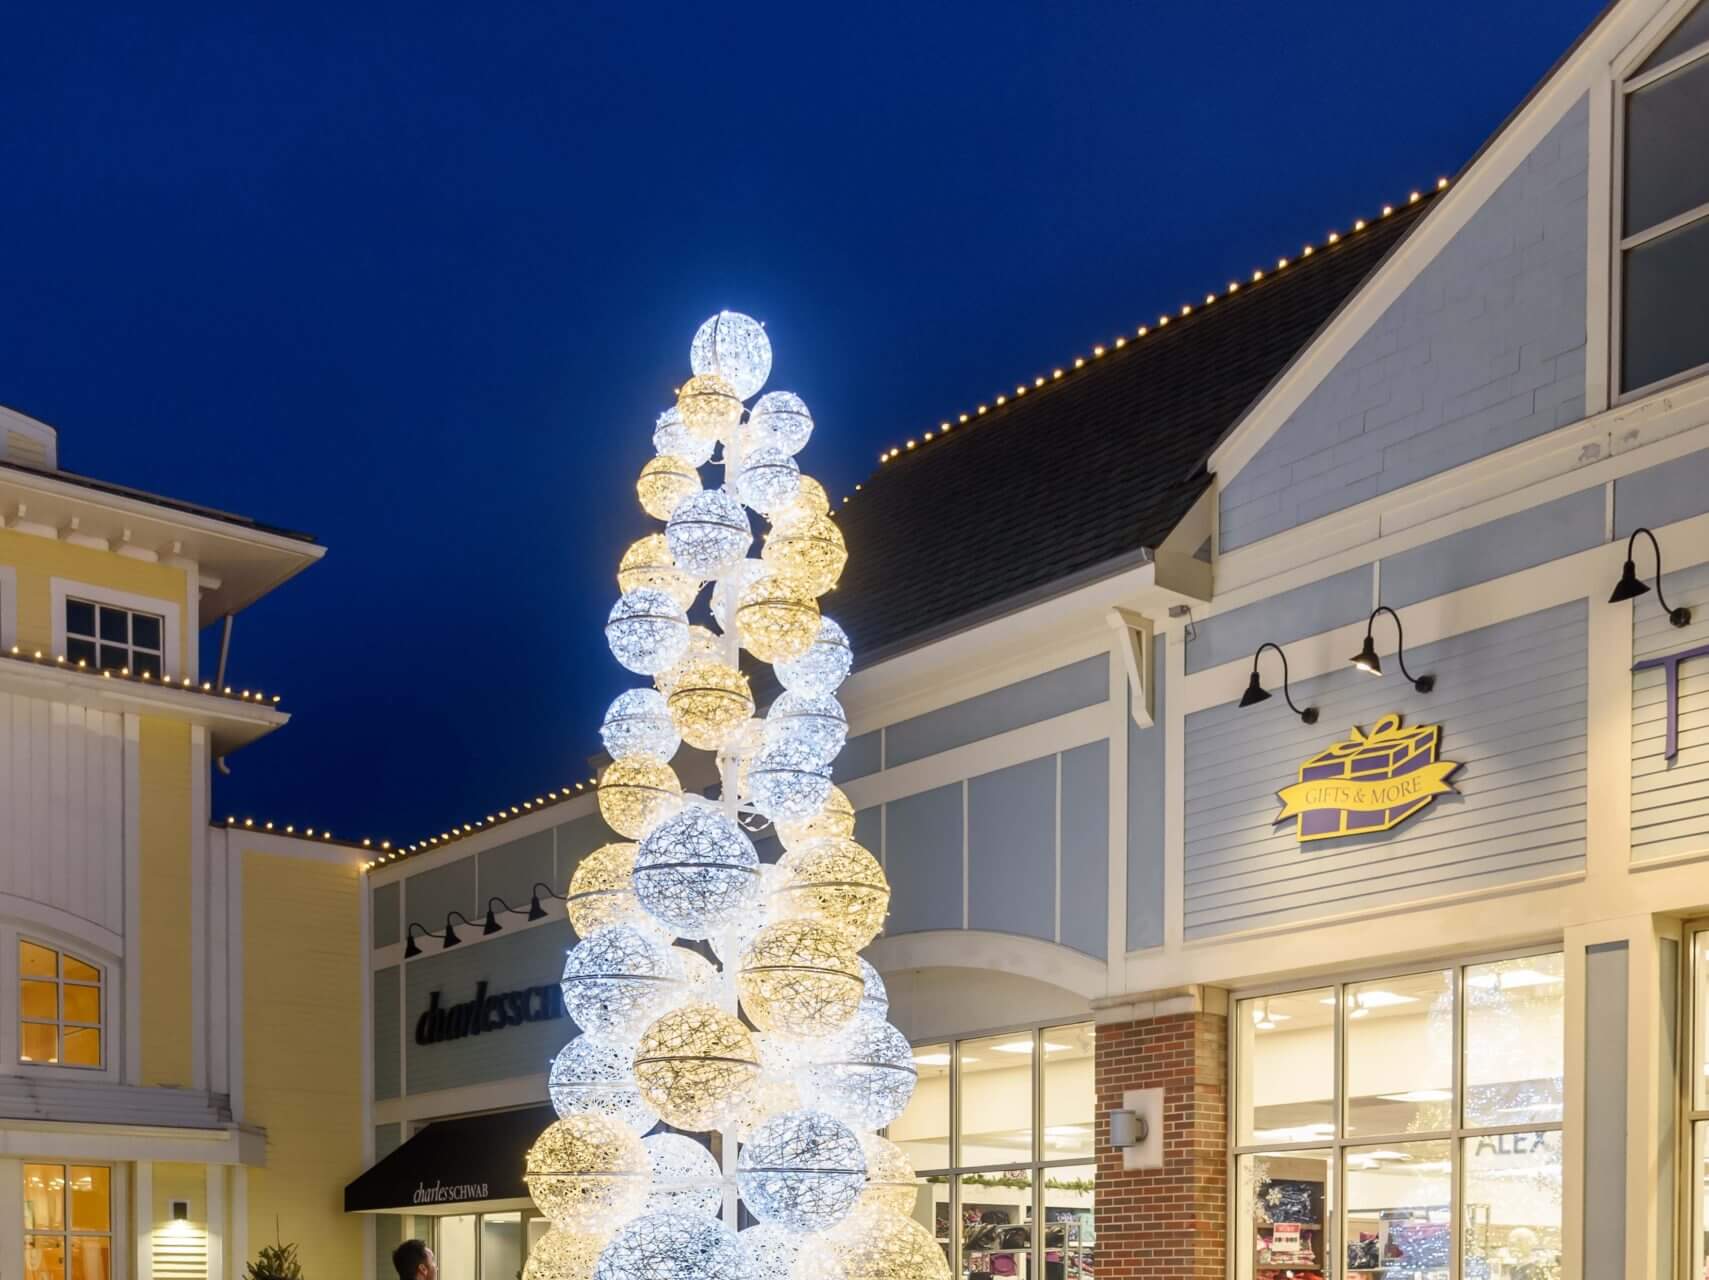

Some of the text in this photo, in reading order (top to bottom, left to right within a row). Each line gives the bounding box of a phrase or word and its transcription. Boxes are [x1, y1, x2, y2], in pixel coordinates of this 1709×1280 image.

[1304, 776, 1422, 805] GIFTS & MORE
